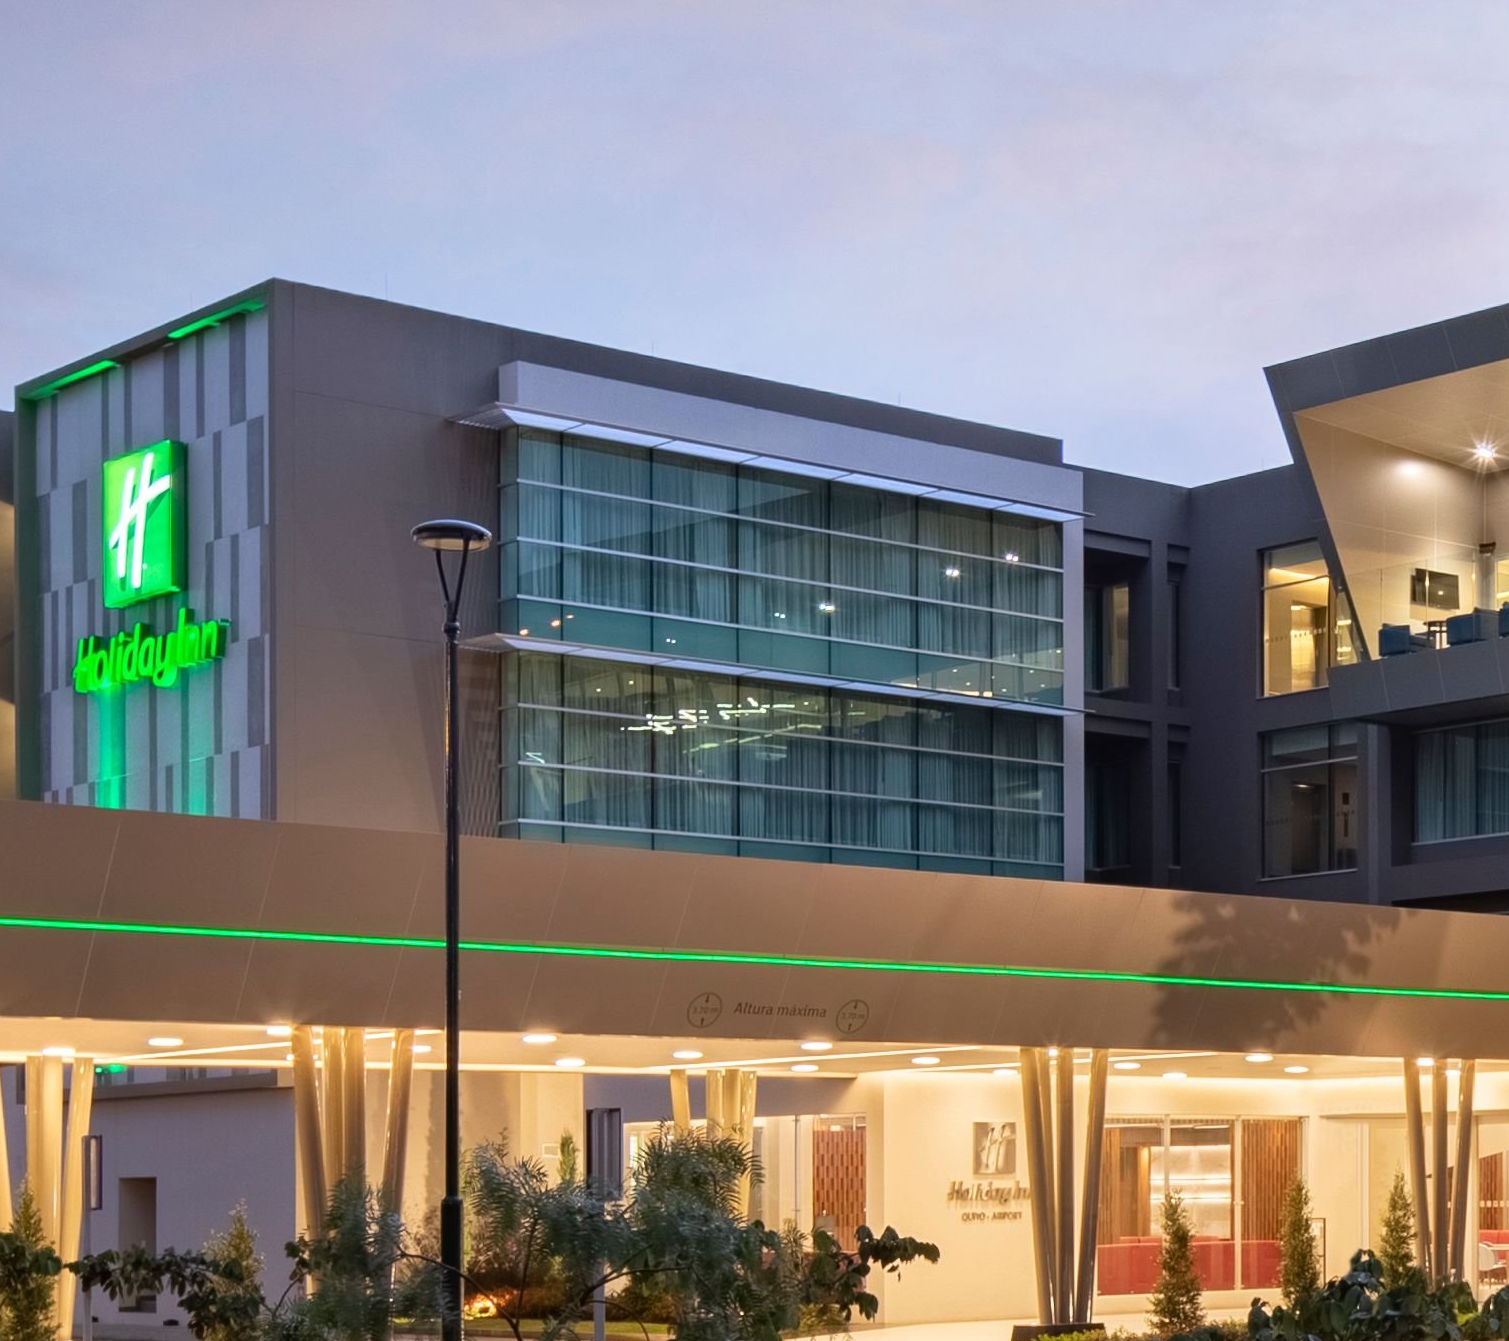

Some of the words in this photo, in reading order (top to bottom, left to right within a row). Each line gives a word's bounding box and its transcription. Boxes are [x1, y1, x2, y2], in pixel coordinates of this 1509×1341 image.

[73, 621, 179, 693] Holiday
[176, 607, 220, 668] Inn
[733, 1002, 774, 1016] Altura
[776, 1004, 827, 1018] máxima
[946, 1180, 1012, 1205] Holiday
